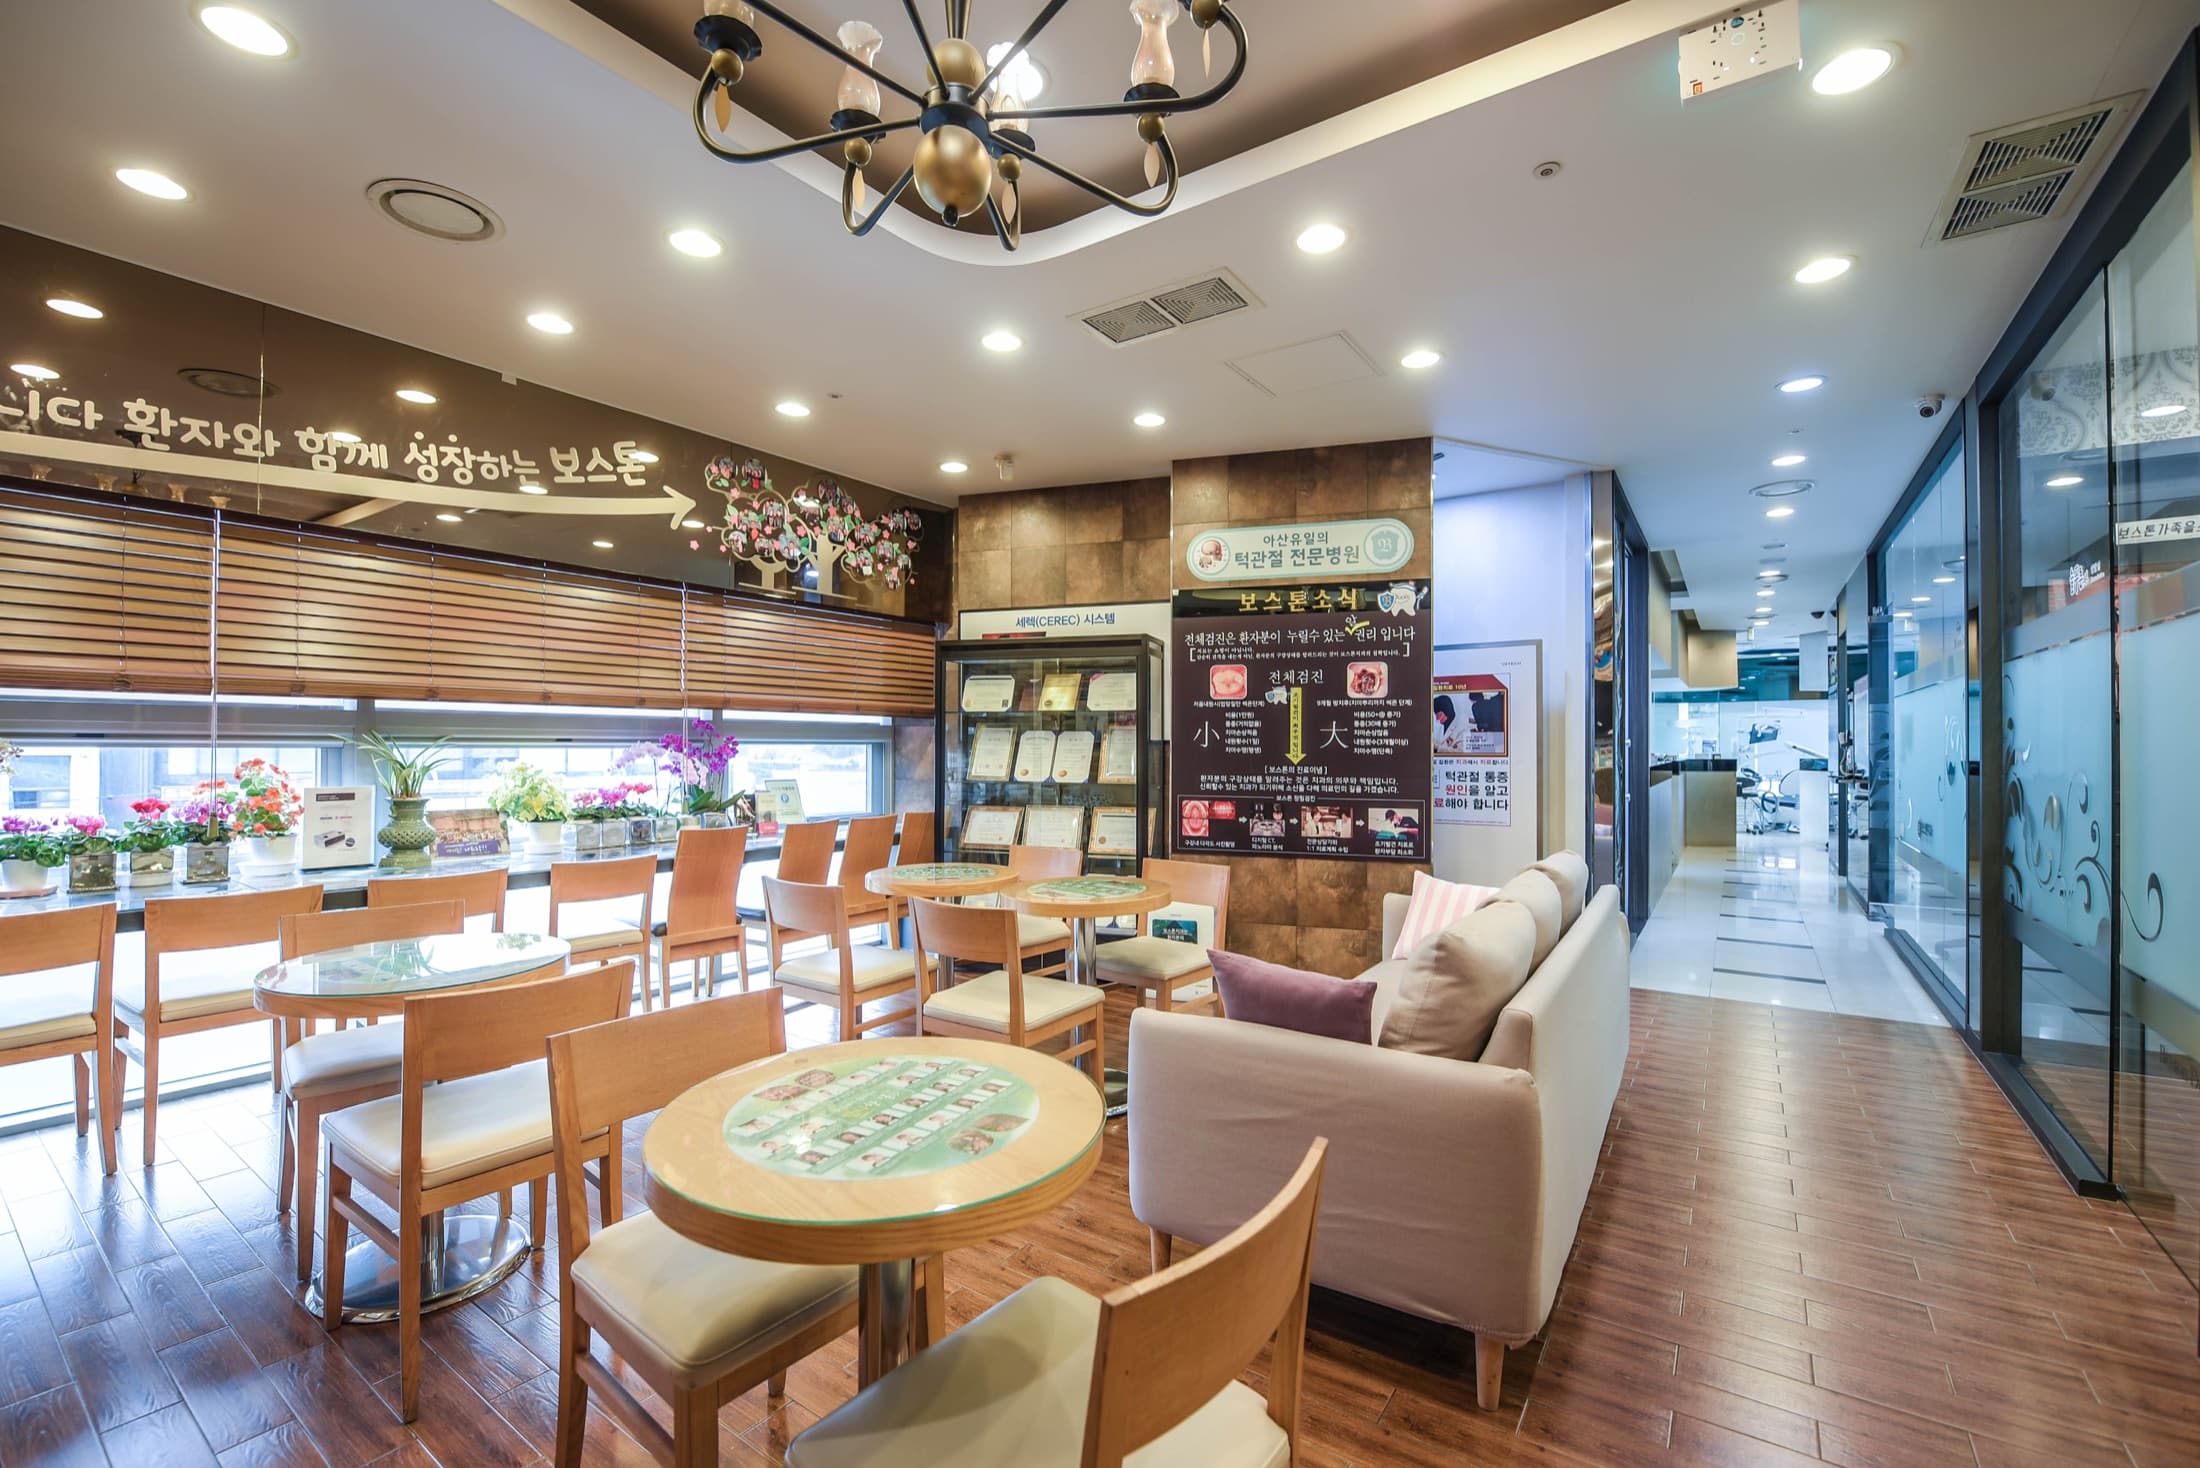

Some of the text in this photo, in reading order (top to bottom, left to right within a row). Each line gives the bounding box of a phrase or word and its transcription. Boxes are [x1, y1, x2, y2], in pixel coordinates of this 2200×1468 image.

[123, 398, 281, 457] 환자와
[295, 427, 388, 472] 함께
[404, 431, 541, 488] 성장하는
[551, 440, 647, 487] 보스톤
[1263, 531, 1329, 548] 아산유일의
[1235, 545, 1360, 569] 턱관절 전문병원
[1015, 612, 1116, 628] 세렉(CEREC) 시스템
[1239, 630, 1281, 645] 환자분이
[1287, 628, 1320, 644] 누릴수
[1323, 628, 1345, 643] 있는
[1380, 625, 1416, 641] 입니다
[1268, 670, 1324, 684] 전체검진
[1193, 721, 1220, 747] 小
[1319, 720, 1349, 749] 大
[1445, 771, 1479, 783] 턱관절
[1484, 771, 1509, 783] 통증
[1446, 784, 1509, 796] 원인을 알고
[1473, 798, 1509, 812] 합니다
